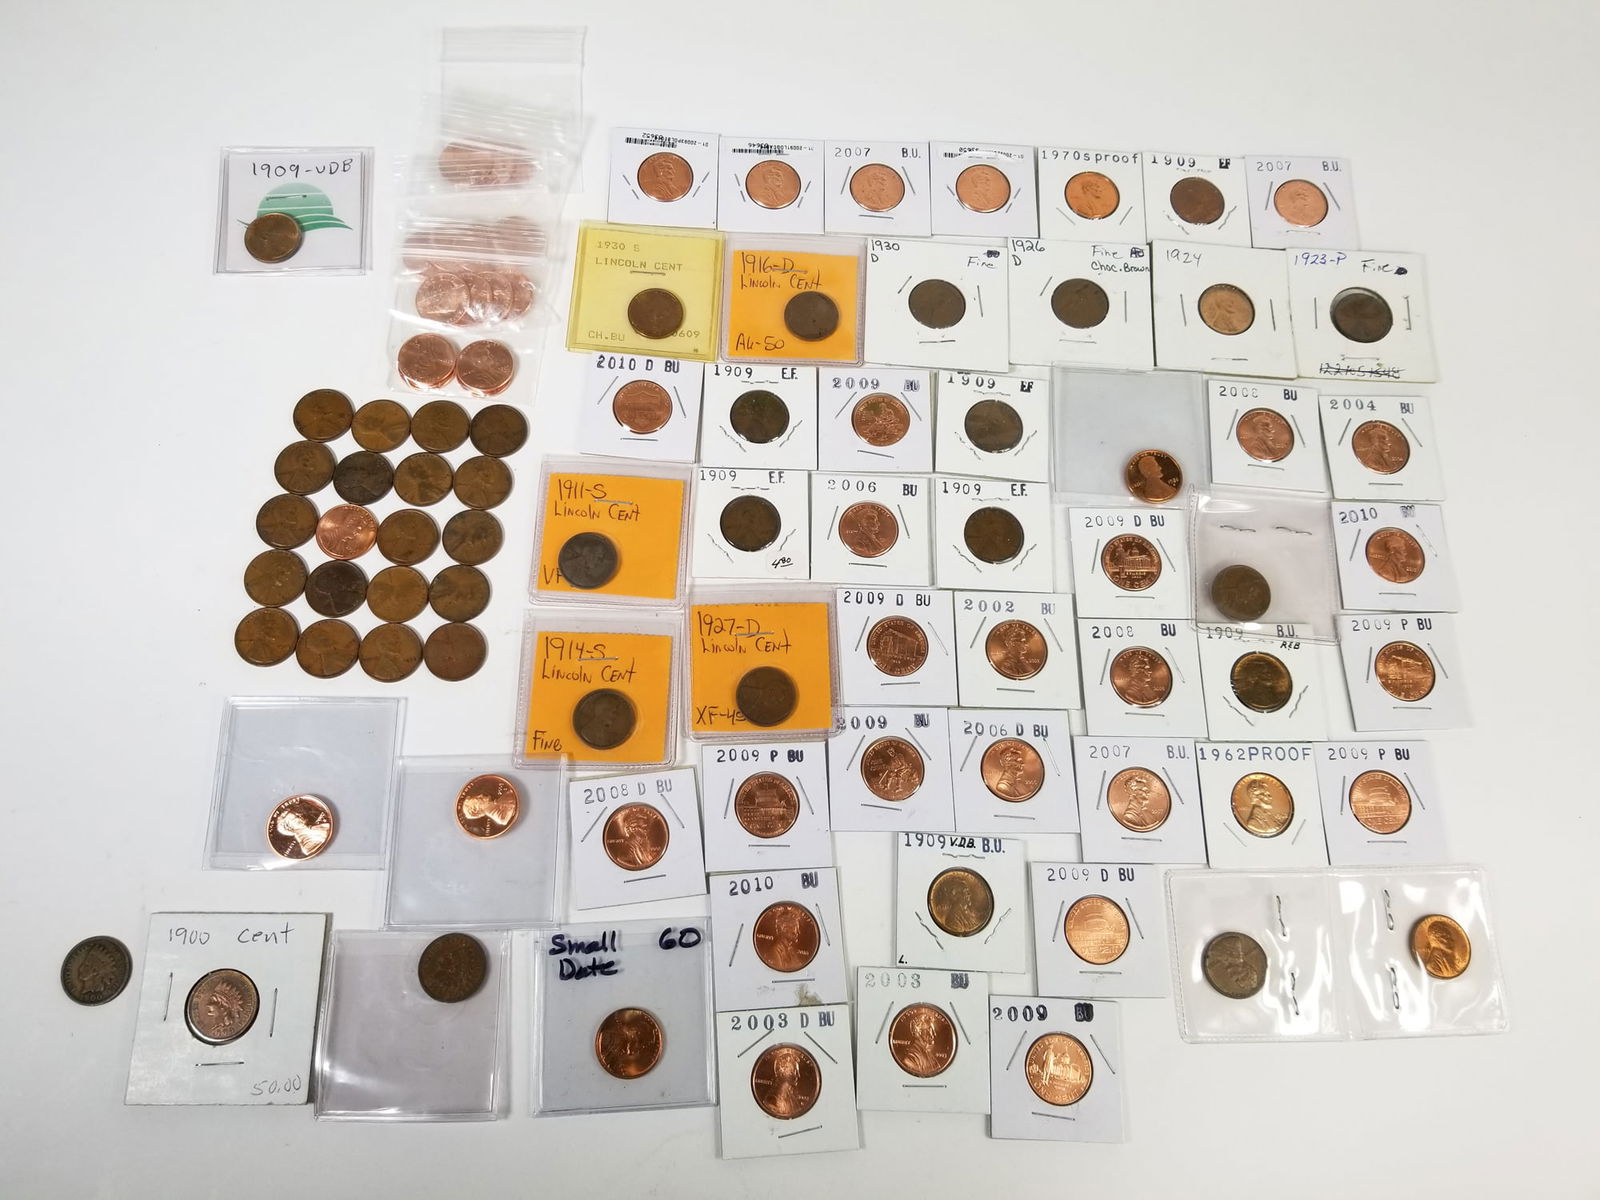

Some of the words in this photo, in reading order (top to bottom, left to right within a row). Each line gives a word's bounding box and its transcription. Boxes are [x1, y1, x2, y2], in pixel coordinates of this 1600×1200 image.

[834, 147, 871, 158] 2007
[901, 147, 922, 159] B.U.
[1151, 155, 1196, 168] 1909
[1257, 160, 1292, 172] 2007
[1322, 161, 1342, 172] B.U.
[597, 241, 626, 251] 1930
[633, 243, 640, 252] S
[871, 239, 900, 251] 1930
[1012, 239, 1045, 252] 1926
[595, 257, 647, 269] LINCOLN
[654, 262, 682, 272] CENT
[741, 252, 795, 274] 1916-D
[871, 254, 879, 263] D
[1013, 254, 1022, 266] D
[1166, 249, 1201, 268] 1924
[1294, 252, 1347, 266] 1923-P
[596, 355, 636, 372] 2010
[645, 359, 653, 372] D
[664, 359, 680, 374] BU
[713, 364, 753, 379] 1909
[832, 377, 880, 390] 2009
[947, 373, 996, 389] 1909
[1283, 388, 1298, 401] BU
[1330, 398, 1377, 412] 2004
[1400, 402, 1415, 414] BU
[700, 469, 737, 482] 1909
[558, 478, 607, 501] 1911-S
[827, 479, 877, 493] 2006
[902, 483, 918, 497] BU
[943, 481, 982, 496] 1909
[1085, 515, 1125, 528] 2009
[1133, 515, 1142, 527] D
[1150, 515, 1165, 528] BU
[1339, 507, 1378, 524] 2010
[843, 590, 885, 605] 2009
[896, 593, 904, 607] D
[916, 593, 931, 607] BU
[964, 598, 1015, 614] 2002
[1041, 602, 1056, 615] BU
[697, 611, 761, 638] 1927-D
[1092, 626, 1134, 639] 2008
[1160, 623, 1177, 638] BU
[1276, 624, 1299, 638] B.U.
[1352, 618, 1391, 632] 2009
[1401, 618, 1409, 631] P
[1417, 617, 1433, 631] BU
[545, 636, 607, 661] 1914-S
[963, 720, 1008, 737] 2006
[1033, 724, 1049, 738] BU
[716, 748, 760, 763] 2009
[770, 750, 779, 762] P
[787, 749, 804, 763] BU
[1089, 745, 1131, 759] 2007
[1166, 745, 1190, 760] B.U.
[1328, 747, 1368, 761] 2009
[1378, 748, 1386, 761] P
[1395, 747, 1410, 761] BU
[583, 783, 629, 805] 2008
[638, 782, 646, 796] D
[656, 778, 672, 794] BU
[904, 832, 946, 849] 1909
[981, 837, 1006, 854] B.U.
[1048, 867, 1090, 882] 2009
[1101, 868, 1109, 882] D
[1118, 867, 1135, 882] BU
[729, 876, 774, 896] 2010
[801, 871, 819, 889] BU
[169, 927, 211, 945] 1900
[549, 930, 617, 955] Small
[559, 957, 619, 981] Date
[864, 972, 921, 989] 2003
[731, 1012, 788, 1031] 2003
[800, 1012, 809, 1028] D
[818, 1011, 835, 1028] BU
[993, 1004, 1049, 1022] 2009
[250, 1074, 302, 1096] 50.00
